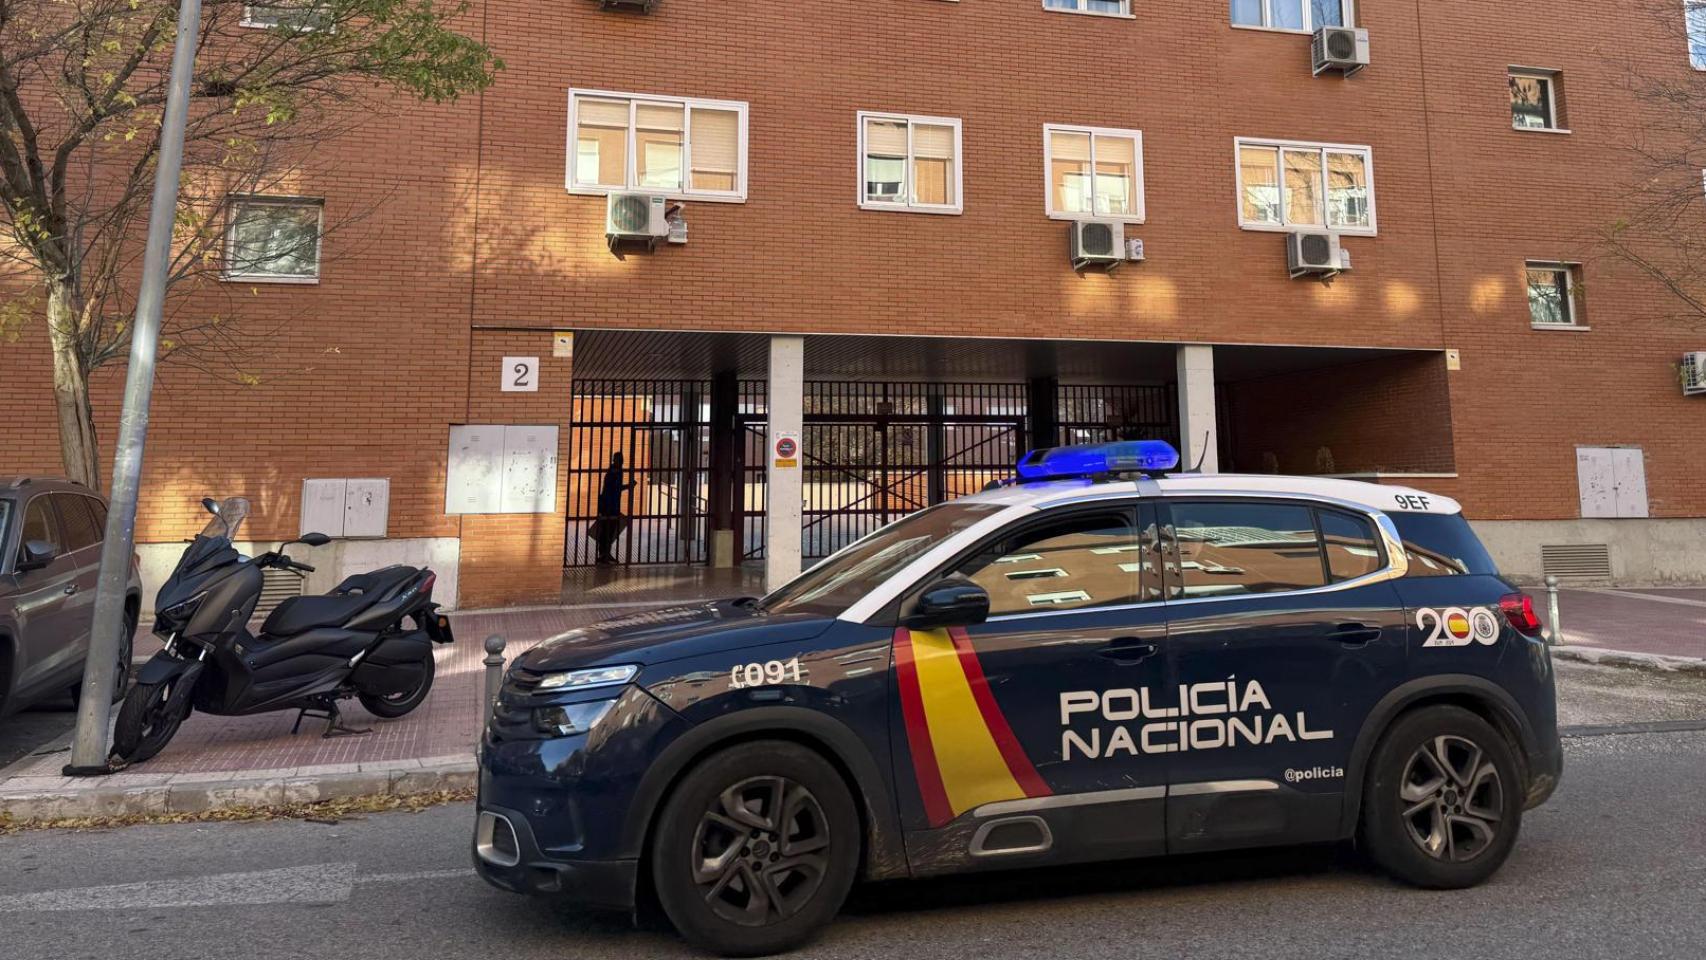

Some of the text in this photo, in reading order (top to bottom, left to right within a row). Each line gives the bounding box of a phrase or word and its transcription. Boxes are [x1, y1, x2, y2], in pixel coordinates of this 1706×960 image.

[514, 363, 529, 387] 2
[1394, 494, 1431, 510] 9EF
[1415, 606, 1500, 647] 200
[744, 657, 801, 686] 091
[1060, 673, 1272, 725] POLICÍA
[1061, 711, 1334, 761] NACIONAL
[1284, 766, 1344, 782] @policia
